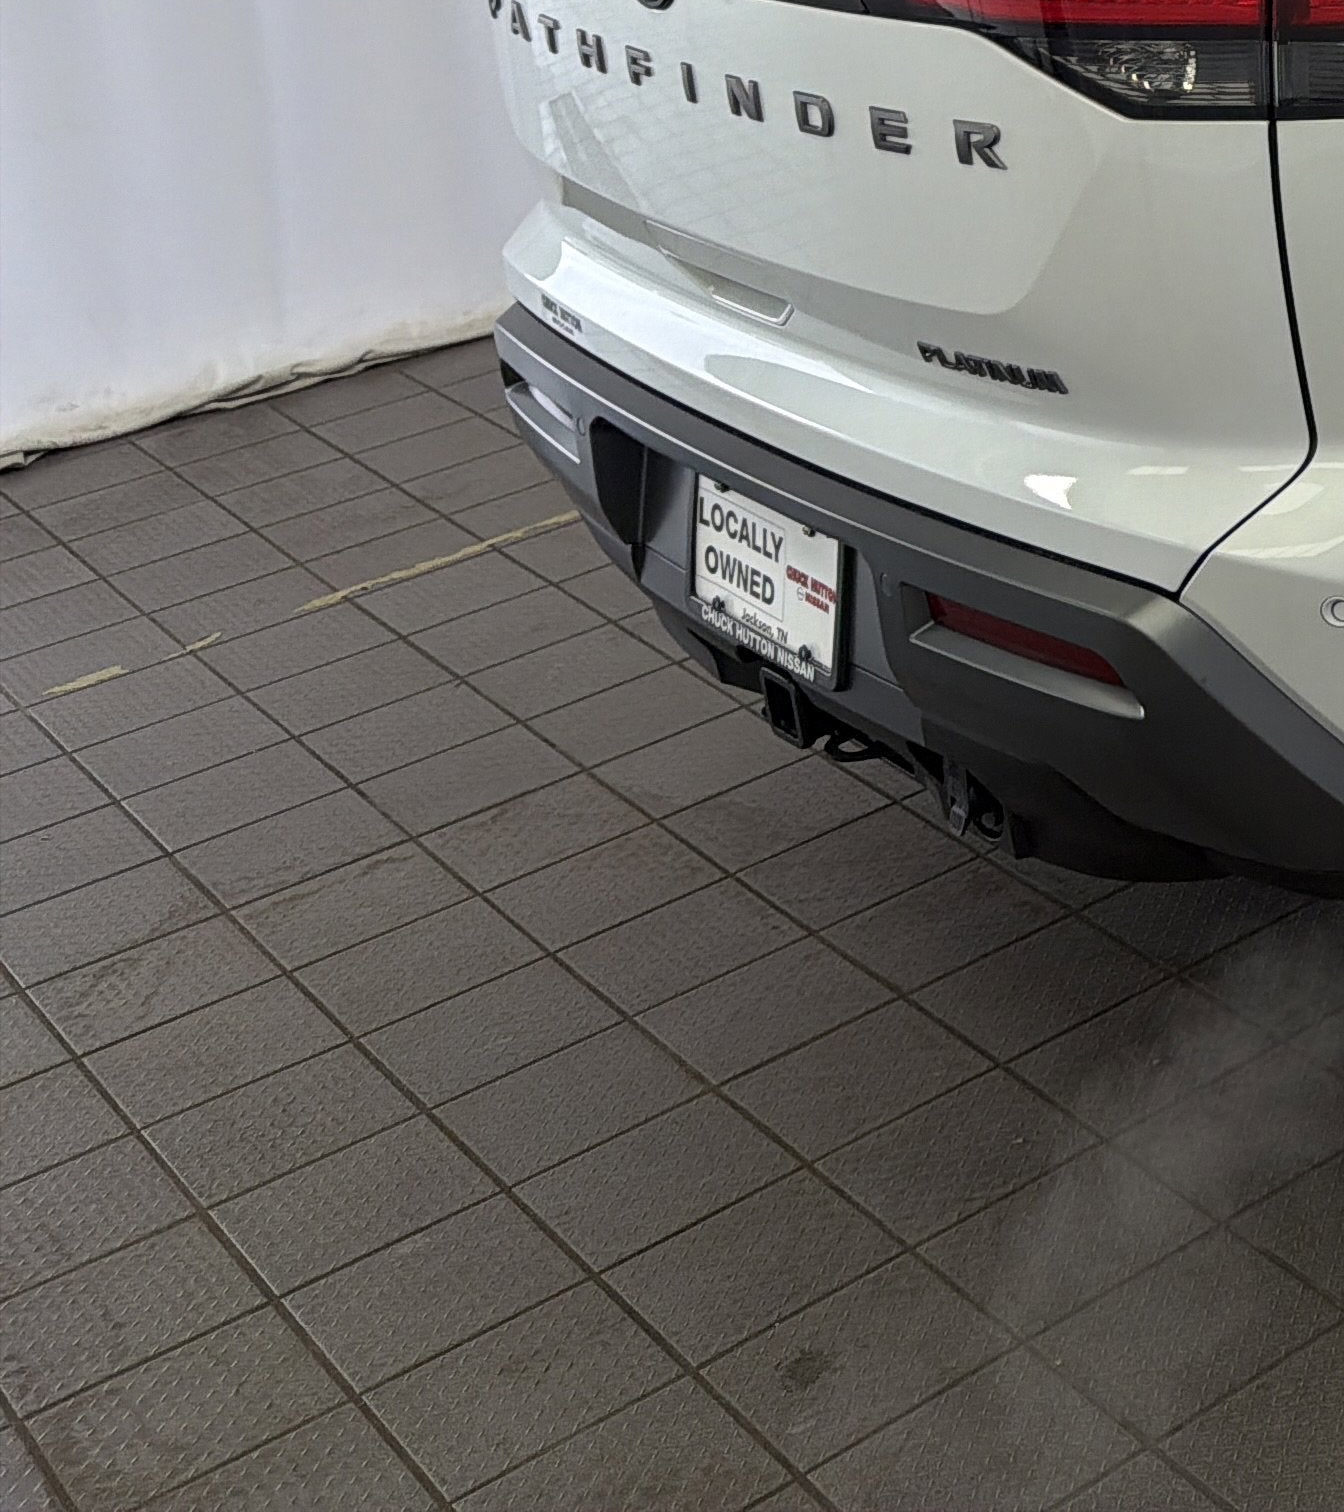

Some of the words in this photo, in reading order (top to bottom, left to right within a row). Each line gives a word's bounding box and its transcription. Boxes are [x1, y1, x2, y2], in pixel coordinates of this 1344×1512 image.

[916, 340, 1070, 396] PLATINUM
[698, 496, 784, 564] LOCALLY
[704, 545, 775, 606] OWNED
[701, 605, 735, 637] CHUCK
[735, 622, 776, 661] HUTTON
[776, 642, 816, 684] NISSAN
